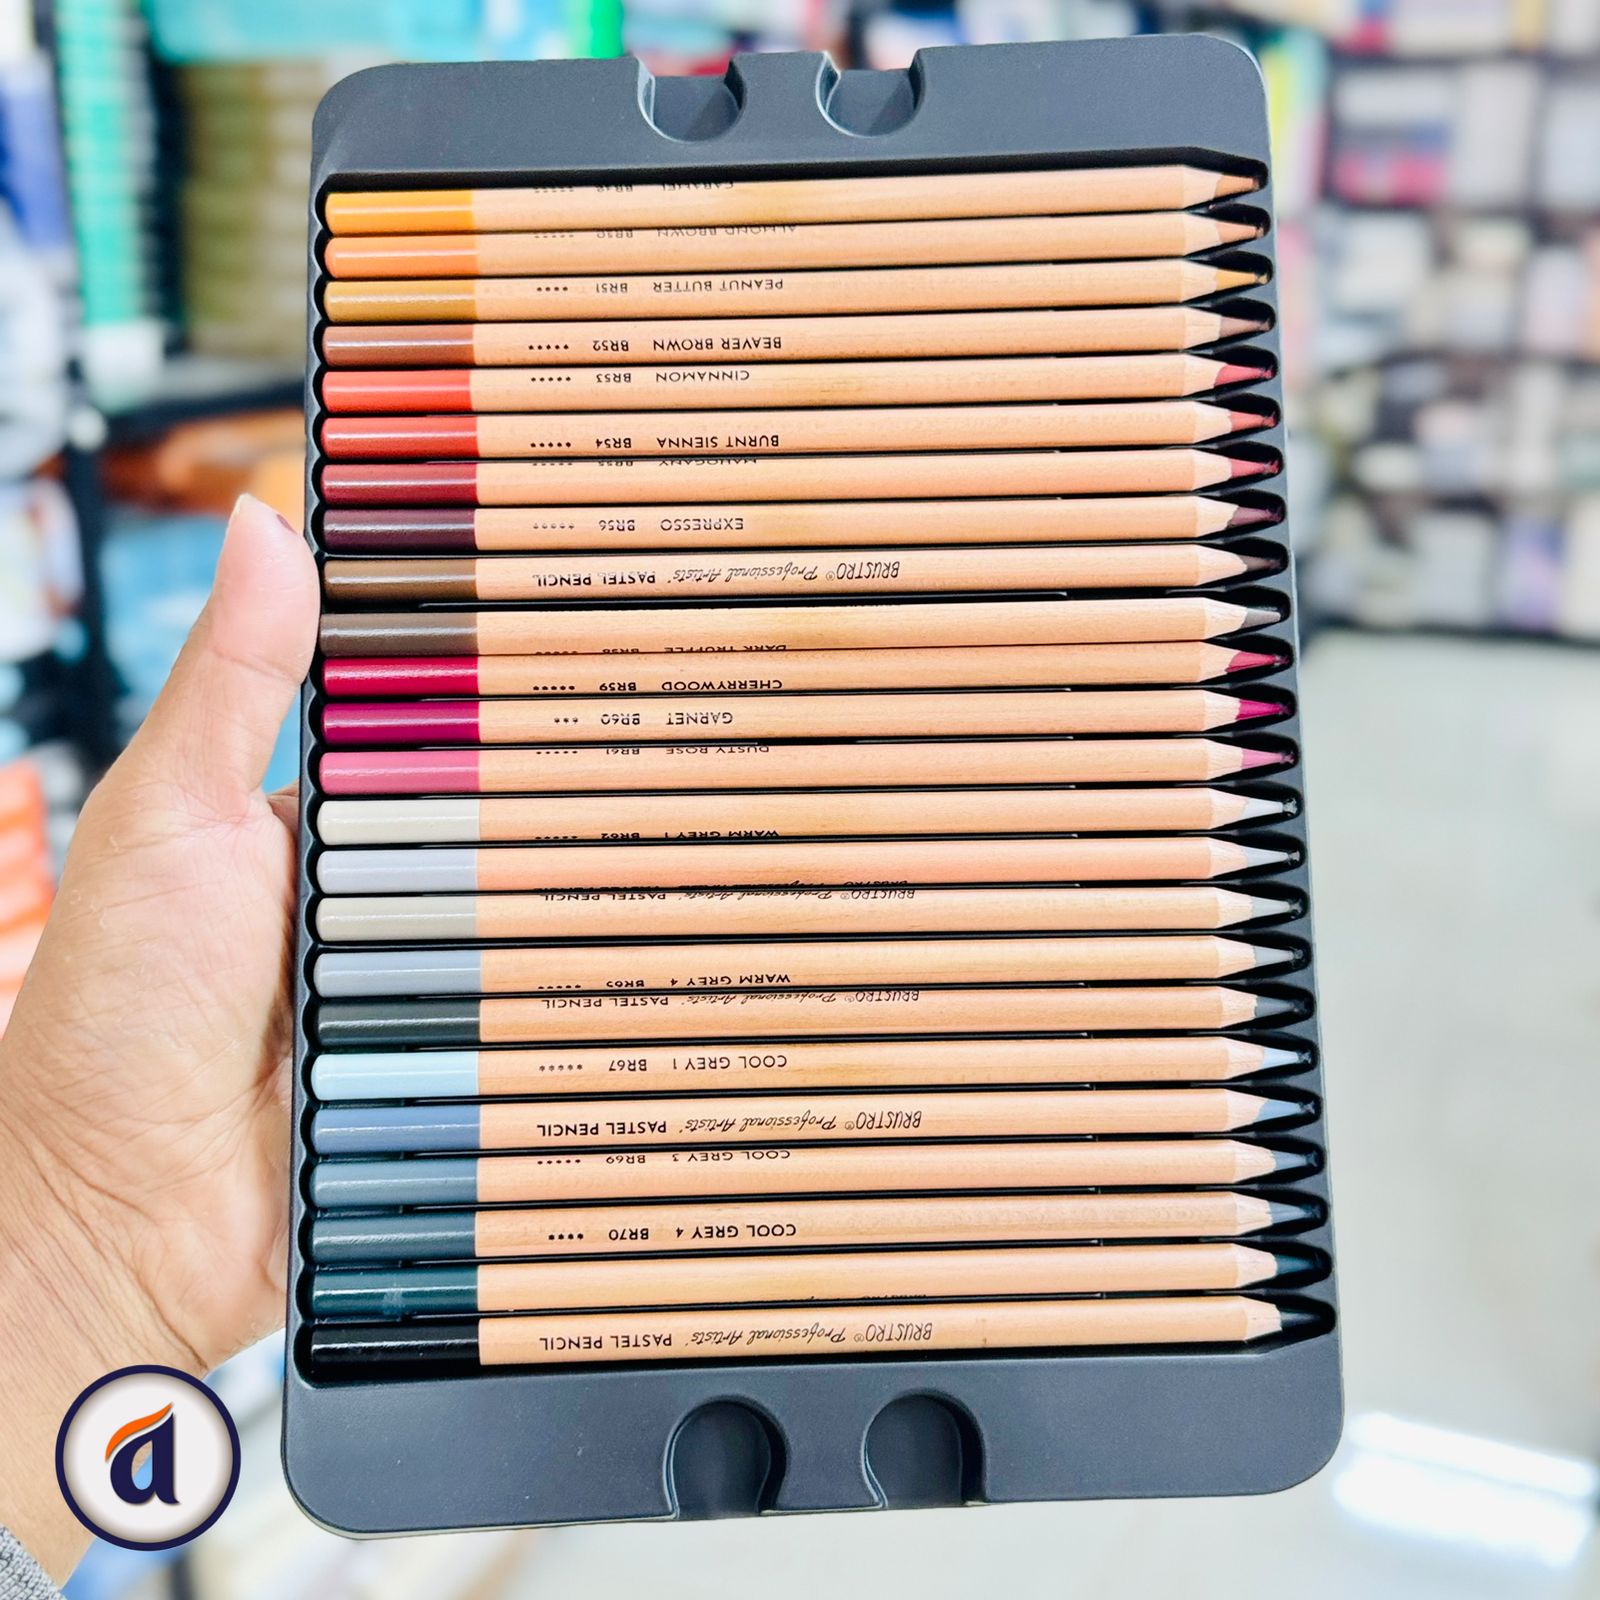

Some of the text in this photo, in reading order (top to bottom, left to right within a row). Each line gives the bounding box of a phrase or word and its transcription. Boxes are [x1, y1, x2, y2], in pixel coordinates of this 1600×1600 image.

[656, 226, 716, 237] BROWN
[595, 278, 784, 293] PEANUT BUTTER BR51
[592, 337, 782, 351] BEAVER BROWN BR52
[596, 370, 750, 383] CINNAMON BR53
[595, 435, 779, 449] BURNT SIENNA BR54
[598, 518, 743, 531] EXPRESSO BR56
[601, 572, 656, 585] PASTEL
[727, 564, 818, 582] Professional
[533, 574, 591, 587] PENCIL
[599, 679, 783, 692] CHERRYWOOD BR59
[600, 712, 733, 725] GARNET BR60
[665, 747, 708, 755] ROSE
[715, 746, 769, 754] DUSTY
[677, 831, 720, 839] GREY
[728, 830, 779, 838] WARM
[540, 893, 600, 901] PENCIL
[607, 892, 666, 901] PASTEL
[670, 978, 678, 987] 4
[687, 976, 731, 986] GREY
[739, 974, 790, 986] WARM
[541, 998, 601, 1009] PENCIL
[609, 996, 668, 1007] PASTEL
[740, 992, 836, 1005] Professional
[608, 1054, 787, 1071] COOL GREY 1 BR67
[740, 1110, 836, 1132] Professional
[536, 1122, 599, 1137] PENCIL
[606, 1120, 667, 1136] PASTEL
[606, 1149, 790, 1164] COOL GREY 3 BR69
[608, 1224, 796, 1241] COOL GREY 4 BR70
[610, 1333, 672, 1348] PASTEL
[749, 1324, 846, 1344] Professional
[539, 1335, 603, 1350] PENCIL
